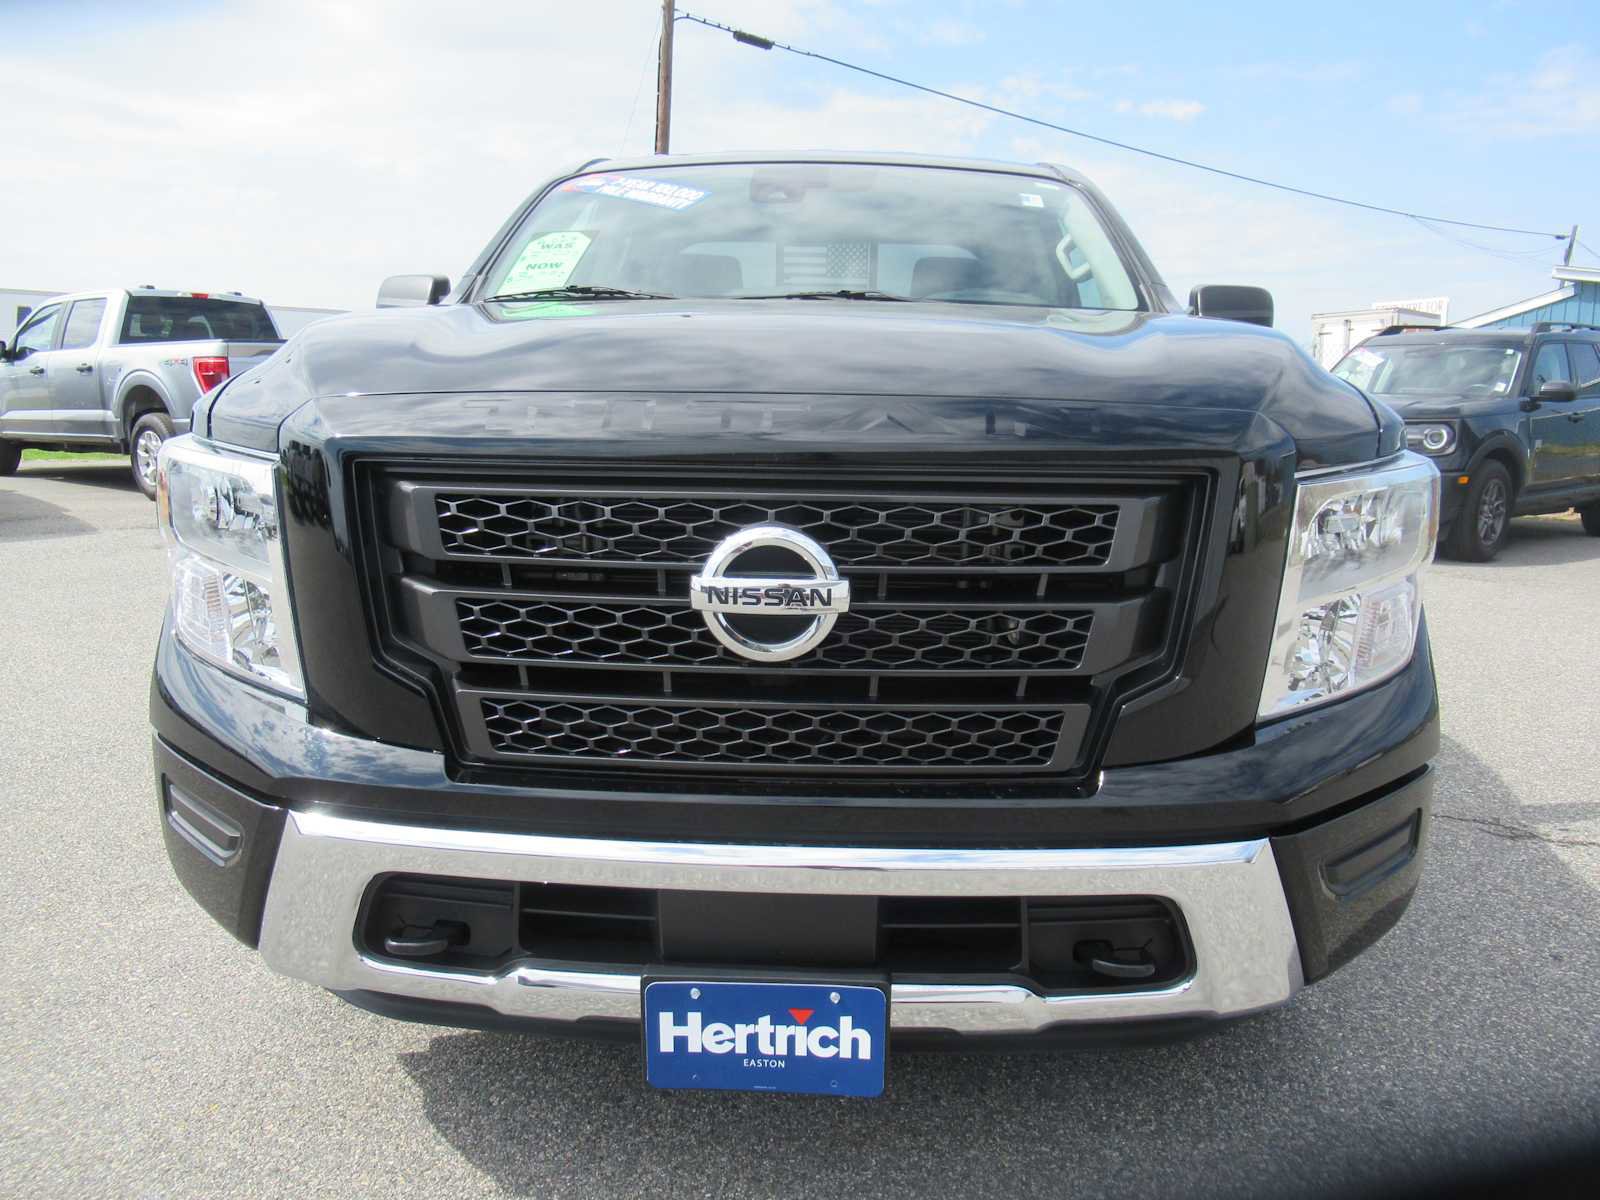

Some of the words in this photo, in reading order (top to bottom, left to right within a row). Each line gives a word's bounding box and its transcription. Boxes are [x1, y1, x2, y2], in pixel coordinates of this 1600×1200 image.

[526, 262, 563, 270] NOW
[706, 585, 832, 607] NISSAN
[658, 1009, 872, 1060] Hertrich
[743, 1058, 785, 1069] EASTON
